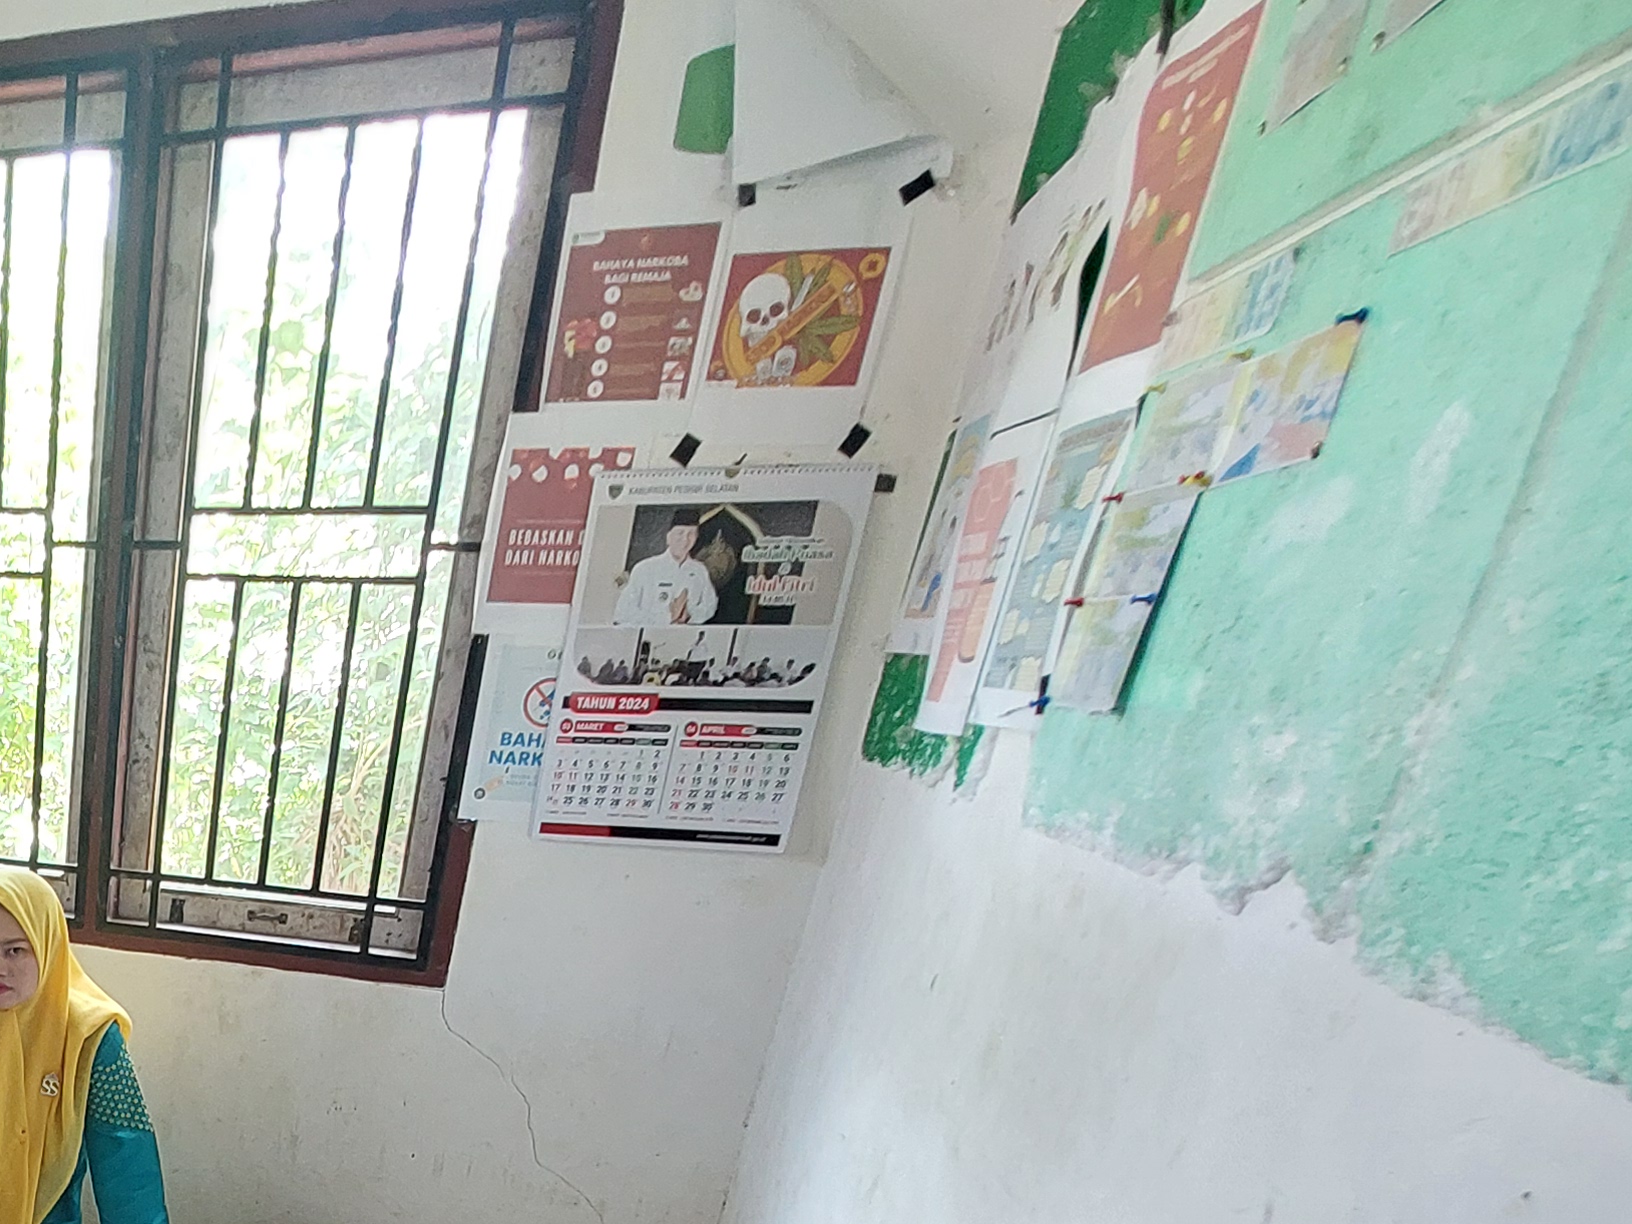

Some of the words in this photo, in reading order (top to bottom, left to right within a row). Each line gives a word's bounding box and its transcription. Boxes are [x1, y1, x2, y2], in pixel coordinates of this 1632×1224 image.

[593, 259, 635, 271] BAHAYA
[508, 529, 574, 545] BEBASKAN
[505, 549, 535, 565] DARI
[577, 697, 616, 709] TAHUN
[618, 698, 650, 710] 2024
[701, 726, 725, 734] APRIL
[715, 752, 721, 760] 2
[784, 754, 790, 762] 6
[557, 759, 562, 767] 3
[696, 764, 701, 772] 8
[714, 764, 718, 772] 9
[569, 772, 577, 780] 11
[584, 773, 593, 781] 12
[648, 775, 657, 783] 16
[708, 777, 718, 785] 16
[742, 778, 751, 786] 18
[775, 780, 786, 788] 20
[582, 785, 590, 793] 19
[688, 790, 698, 798] 22
[738, 791, 748, 799] 25
[772, 793, 783, 801] 27
[579, 797, 588, 805] 26
[685, 802, 695, 810] 29
